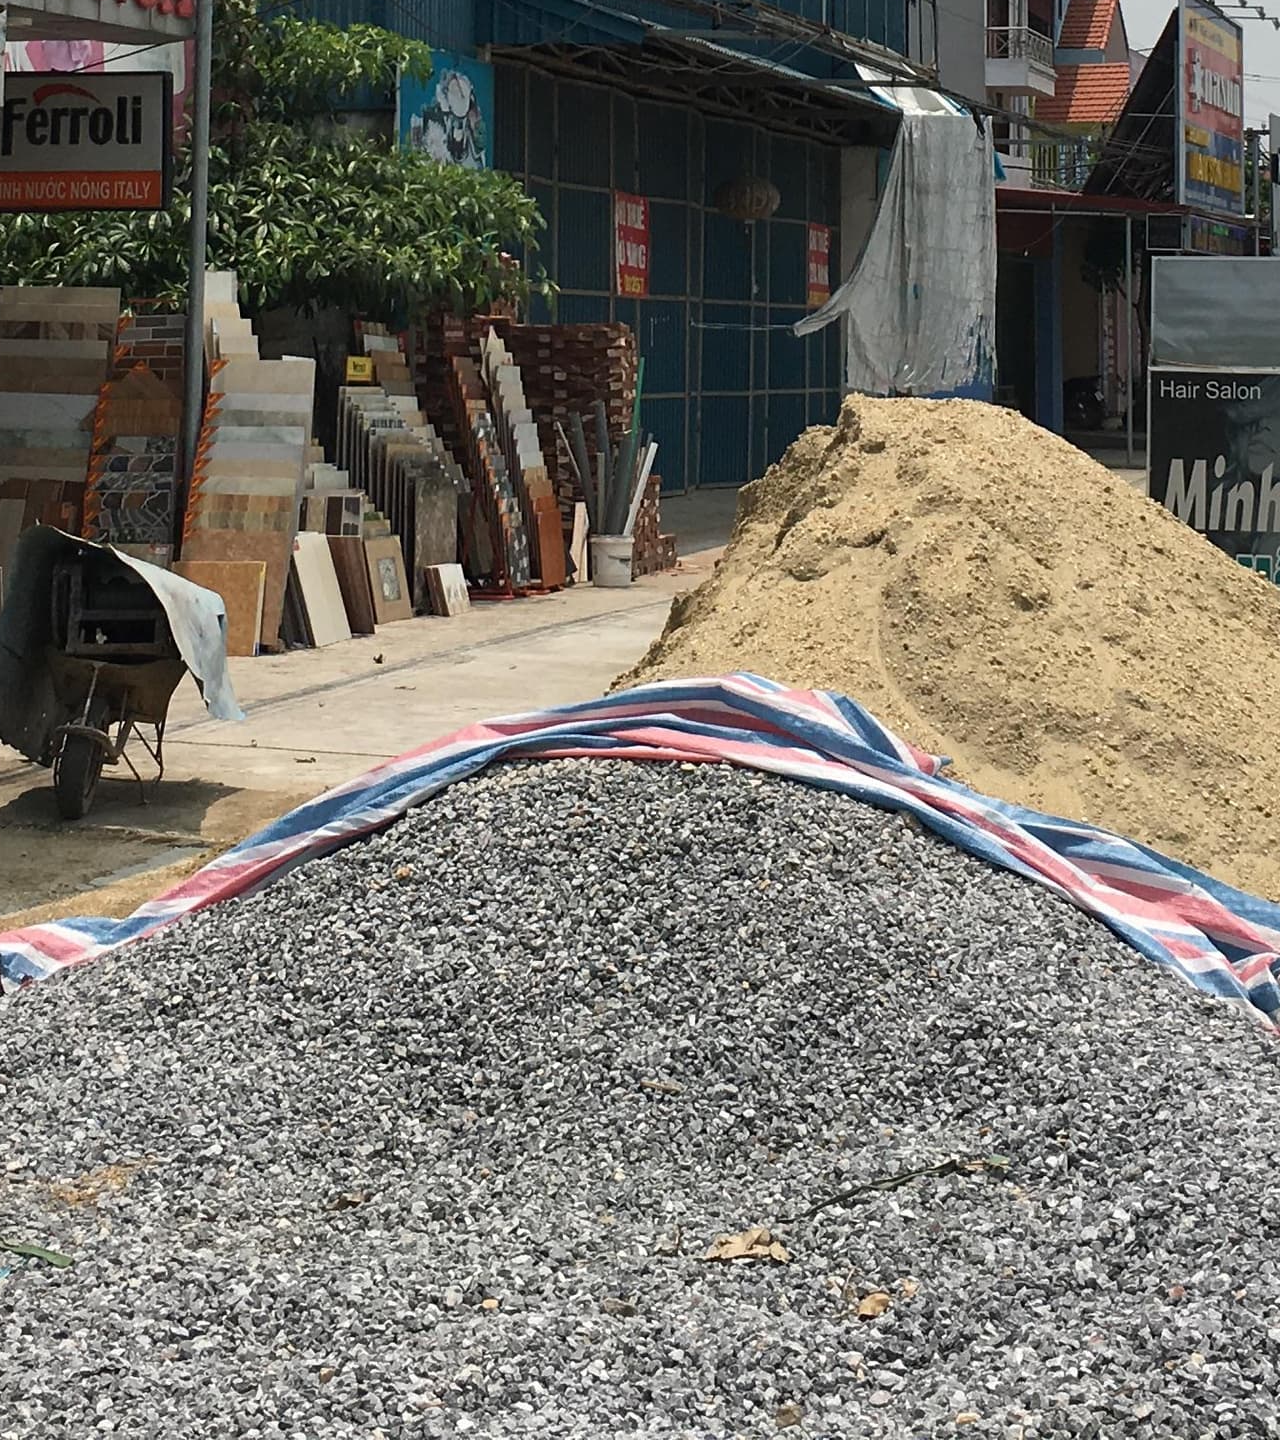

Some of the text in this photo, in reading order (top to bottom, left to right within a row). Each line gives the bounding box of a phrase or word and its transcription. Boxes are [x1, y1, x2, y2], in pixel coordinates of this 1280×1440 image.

[1, 96, 143, 157] Ferroli
[25, 176, 67, 200] NƯỚC
[70, 176, 110, 201] NÓNG
[114, 180, 152, 200] ITALY
[1160, 380, 1261, 401] Hair Salon
